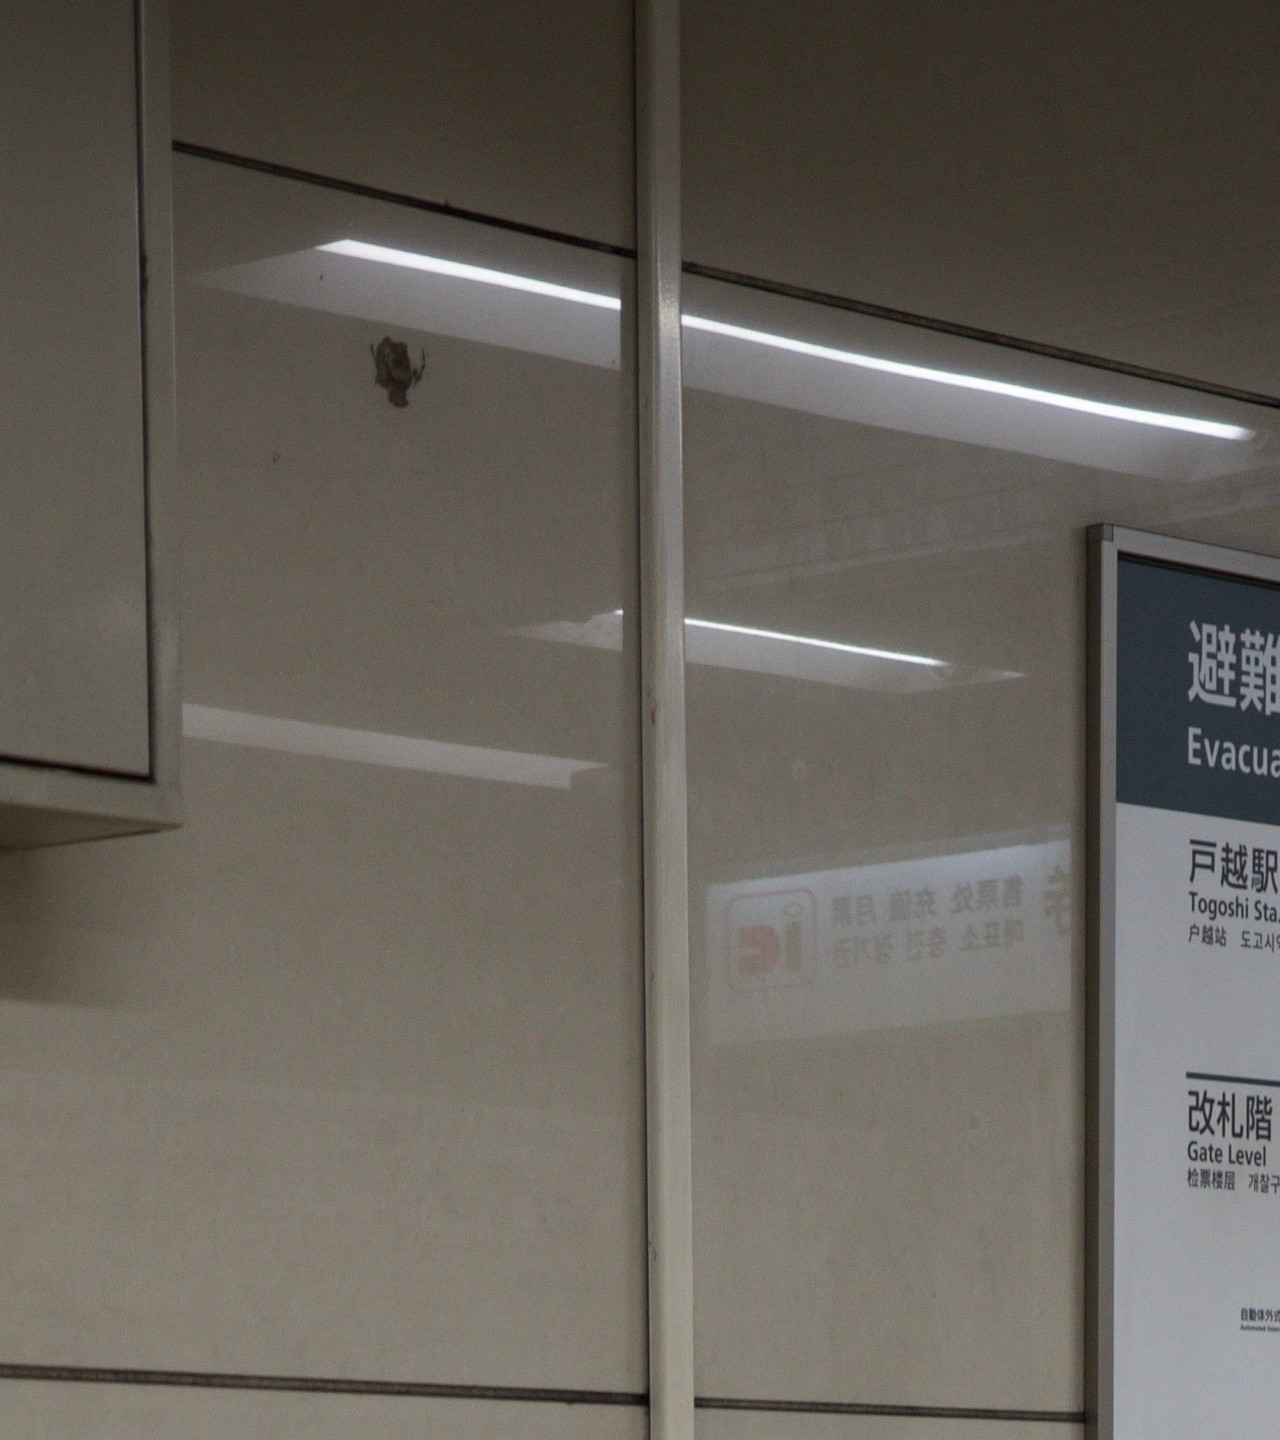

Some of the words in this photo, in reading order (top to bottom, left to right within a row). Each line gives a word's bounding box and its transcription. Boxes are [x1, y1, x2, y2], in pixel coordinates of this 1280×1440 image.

[1189, 838, 1278, 894] 戸越駅
[1188, 891, 1249, 921] Togoshi
[1188, 1089, 1273, 1142] 改札階
[1187, 1141, 1223, 1163] Gate
[1228, 1144, 1267, 1167] Level
